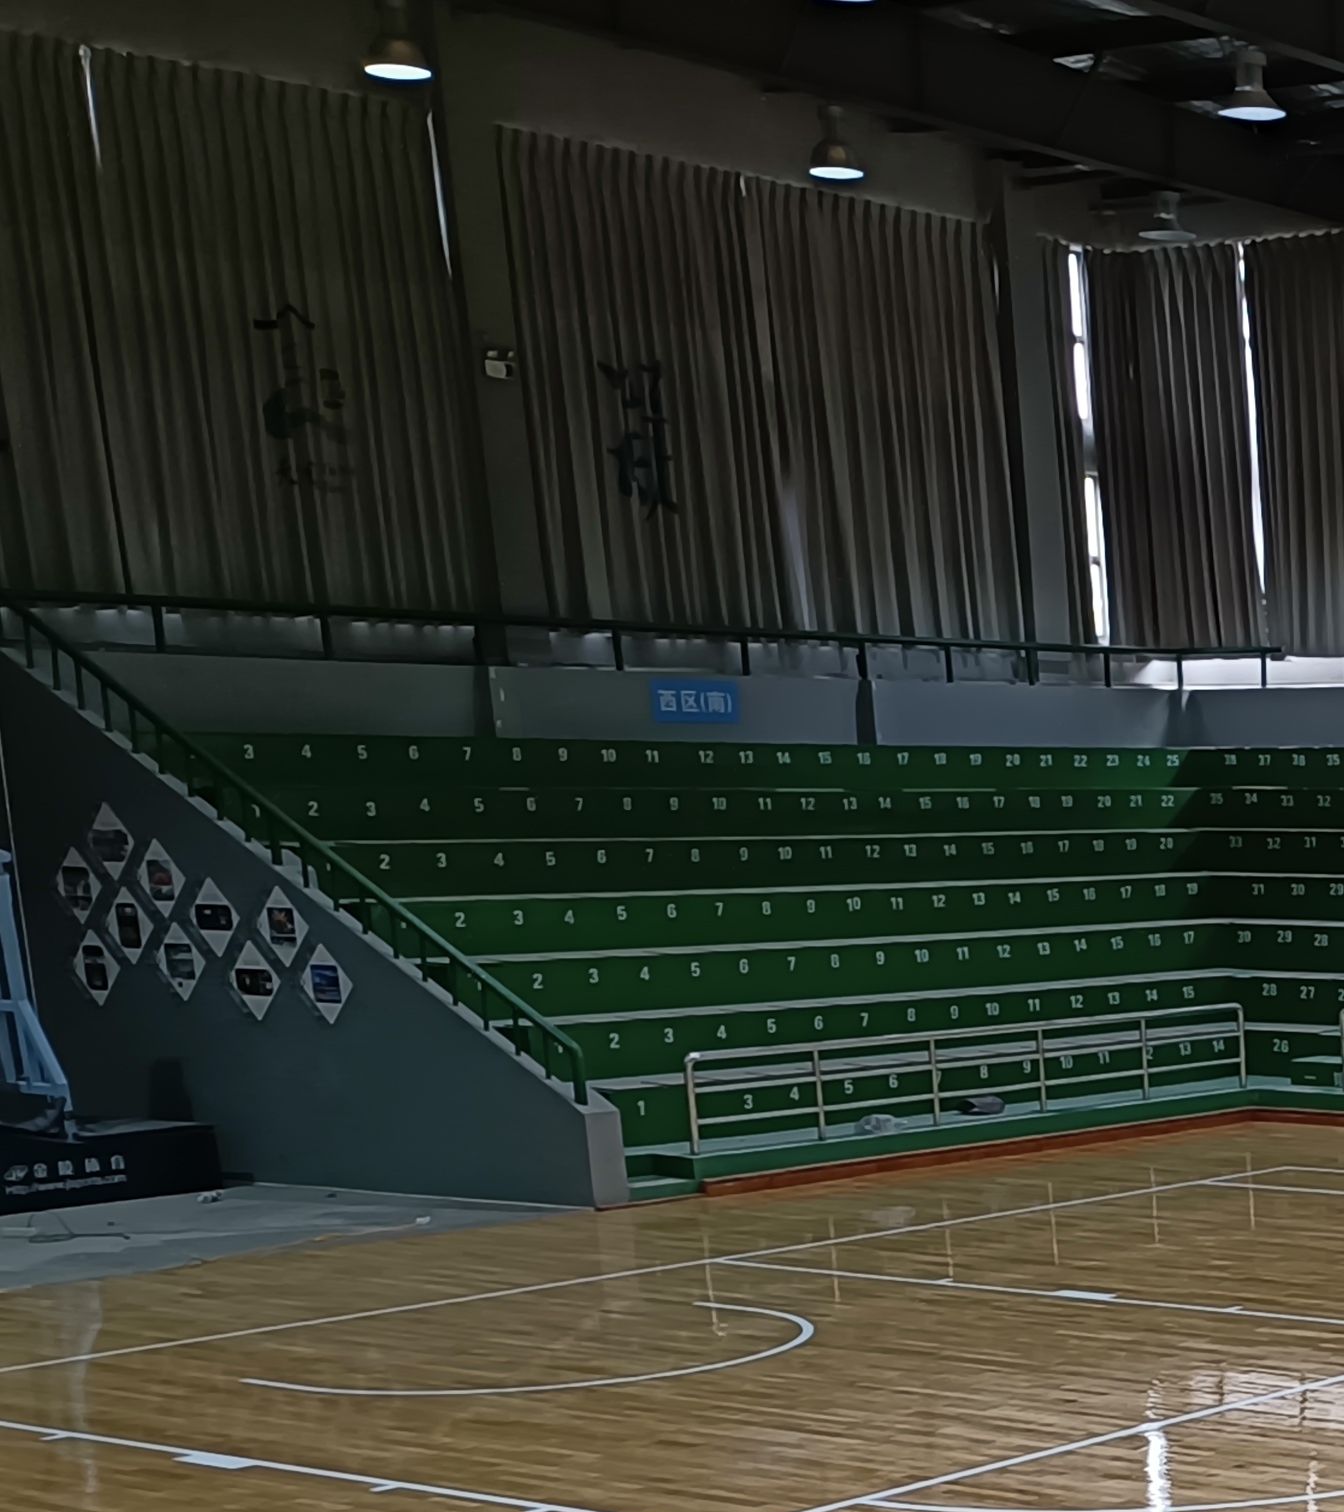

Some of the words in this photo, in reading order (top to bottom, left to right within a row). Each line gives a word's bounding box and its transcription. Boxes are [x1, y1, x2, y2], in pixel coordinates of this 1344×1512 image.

[656, 689, 733, 714] 西区(南)
[243, 743, 255, 760] 3
[300, 743, 313, 759] 4
[356, 744, 368, 760] 5
[408, 744, 420, 760] 6
[462, 746, 472, 761] 7
[600, 748, 617, 763] 10
[644, 748, 660, 764] 11
[697, 749, 715, 764] 12
[738, 750, 755, 765] 13
[775, 751, 792, 765] 14
[1073, 753, 1088, 768] 22
[1105, 753, 1120, 767] 23
[1165, 753, 1181, 768] 25
[307, 800, 320, 817] 2
[365, 800, 377, 817] 3
[419, 797, 431, 812] 4
[473, 797, 485, 813] 5
[1160, 794, 1176, 808] 22
[378, 853, 391, 871] 2
[435, 851, 448, 868] 3
[493, 851, 505, 867] 4
[545, 850, 557, 867] 5
[596, 848, 608, 864] 6
[453, 911, 467, 928] 2
[512, 909, 525, 926] 3
[563, 909, 575, 925] 4
[616, 904, 628, 921] 5
[666, 903, 678, 919] 6
[714, 901, 725, 917] 7
[845, 895, 862, 913] 10
[931, 893, 947, 909] 12
[531, 972, 544, 990] 2
[587, 967, 600, 985] 3
[639, 965, 651, 981] 4
[690, 961, 701, 978] 5
[738, 957, 750, 975] 6
[786, 955, 797, 972] 7
[1299, 984, 1316, 1000] 27
[608, 1032, 621, 1050] 2
[663, 1027, 675, 1044] 3
[716, 1024, 728, 1040] 4
[766, 1017, 777, 1034] 5
[813, 1014, 824, 1031] 6
[636, 1099, 646, 1117] 1
[742, 1093, 754, 1110] 3
[788, 1085, 801, 1102] 4
